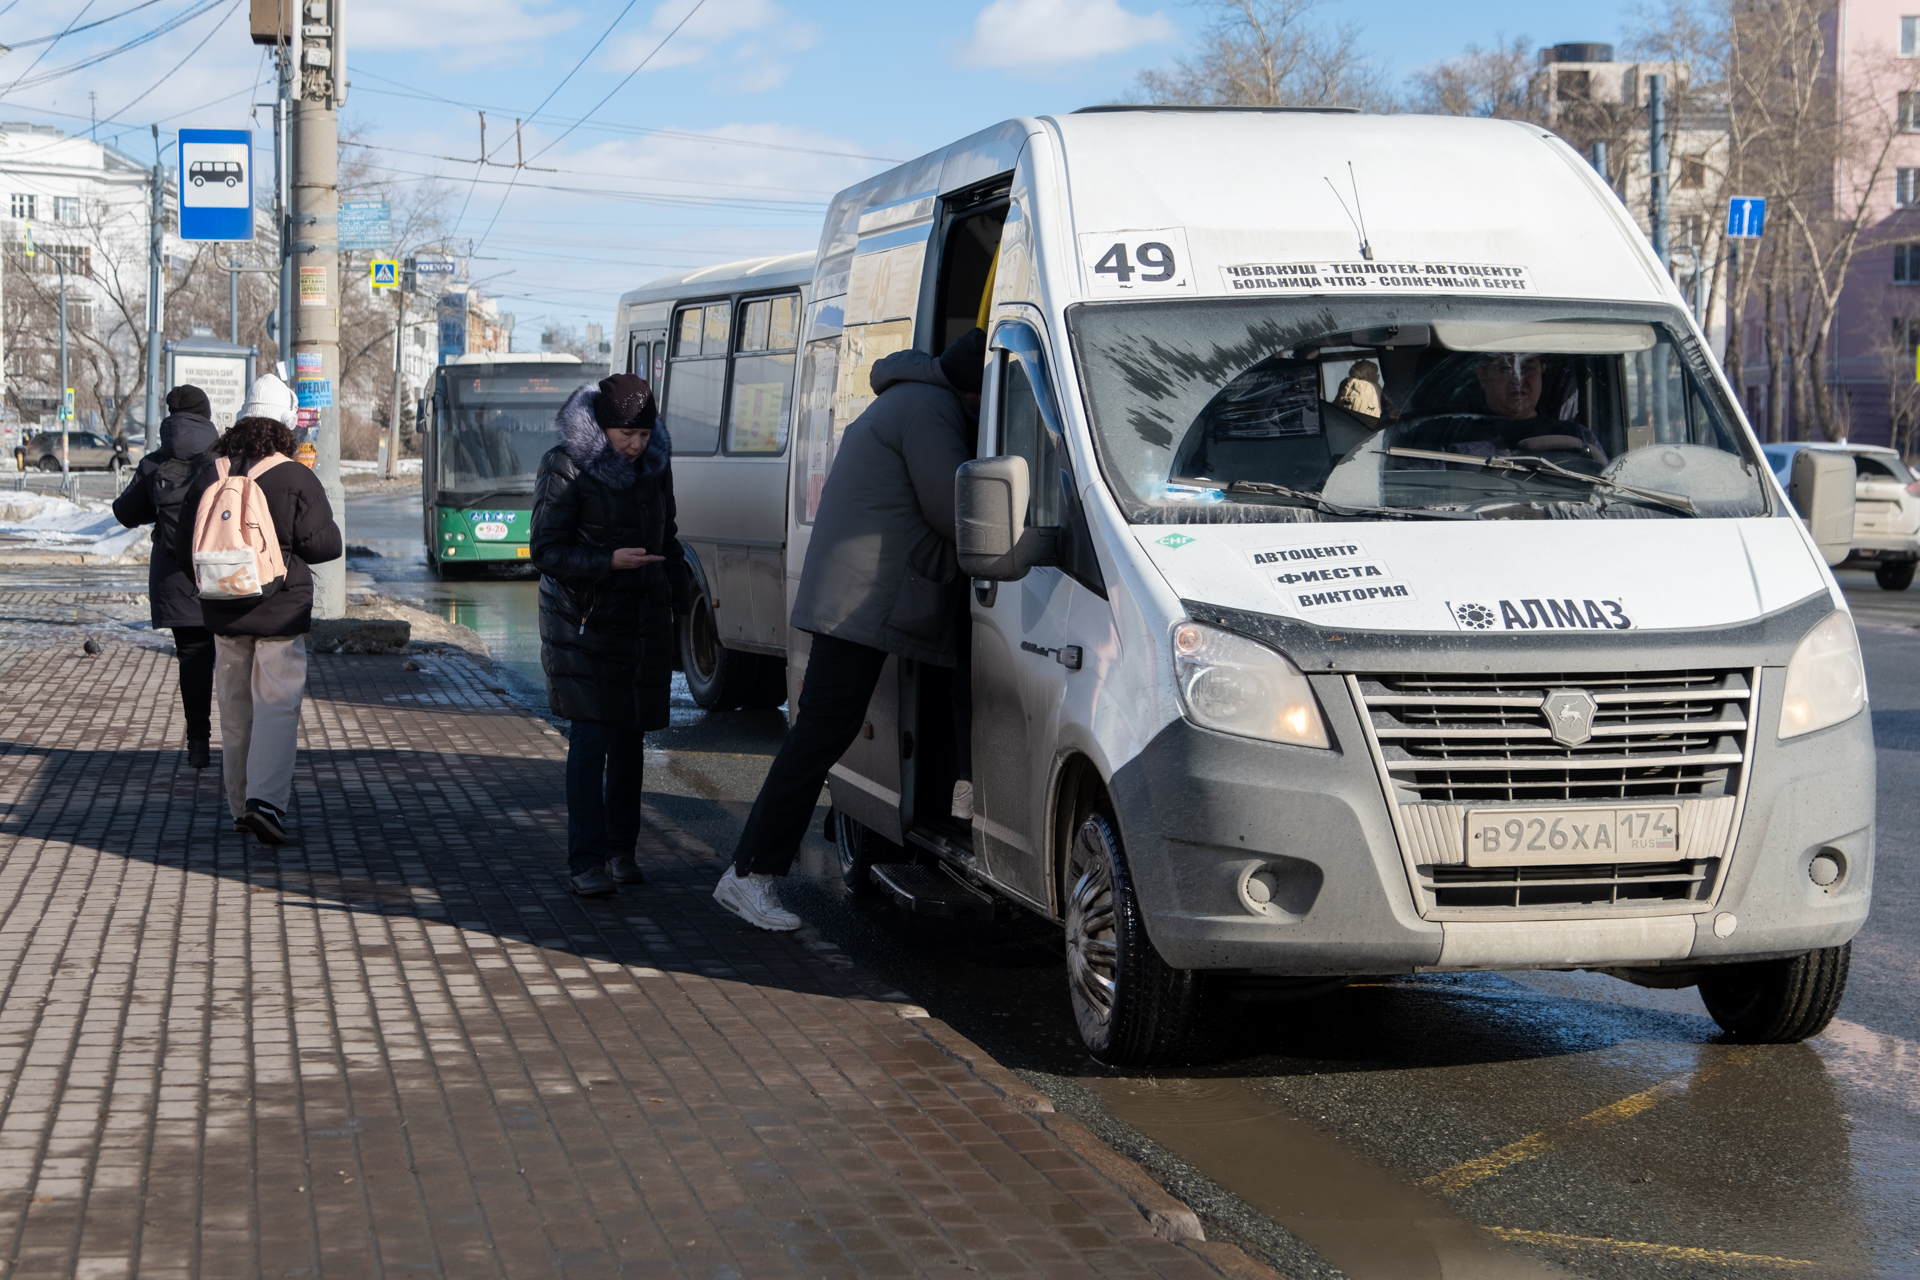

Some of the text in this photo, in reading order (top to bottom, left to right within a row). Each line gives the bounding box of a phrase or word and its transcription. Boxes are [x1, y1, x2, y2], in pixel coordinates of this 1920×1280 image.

[1094, 241, 1176, 282] 49
[1226, 264, 1317, 277] ЧВВАКУШ
[1232, 277, 1322, 289] БОЛЬНИЦА
[1324, 276, 1367, 287] ЧТПЗ
[1379, 276, 1480, 288] СОЛНЕЧНЫЙ
[1482, 278, 1526, 289] БЕРЕГ
[297, 381, 331, 394] КРЕДИТ
[1159, 537, 1190, 545] СНГ
[1253, 545, 1358, 565] АВТОЦЕНТР
[1276, 565, 1382, 585] ФИЕСТА
[1298, 585, 1409, 607] ВИКТОРИЯ
[1498, 599, 1632, 630] АЛМАЗ
[1620, 812, 1668, 839] 174
[1631, 839, 1656, 849] RUS
